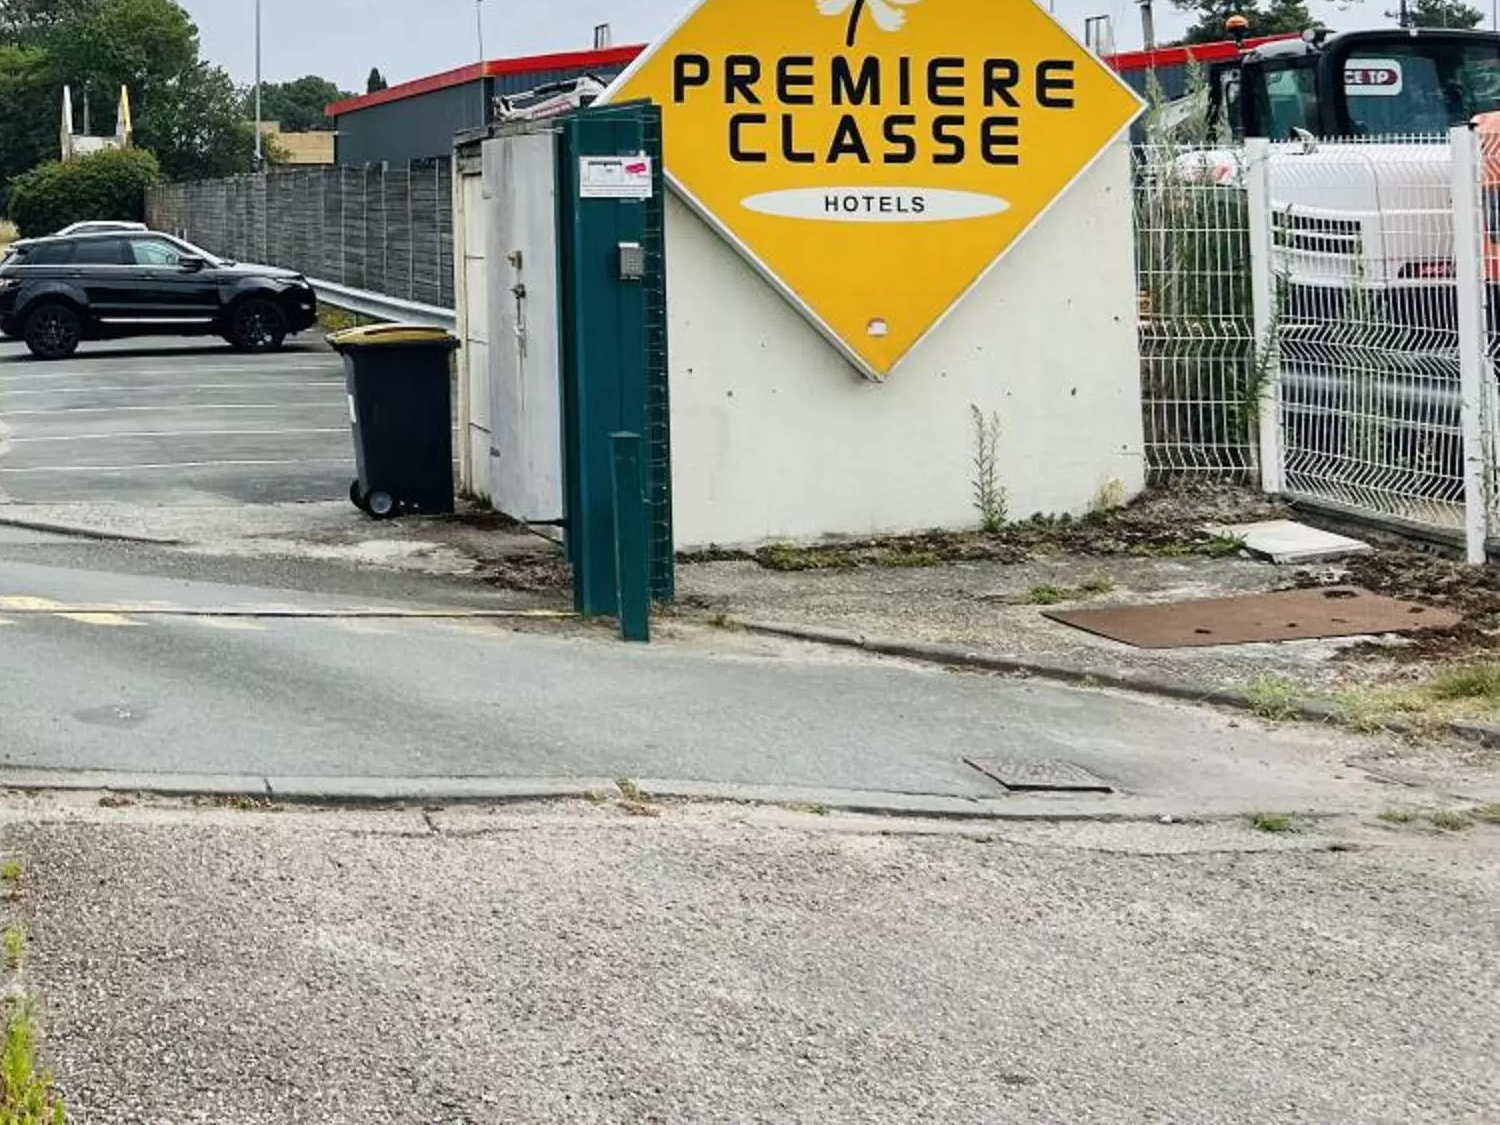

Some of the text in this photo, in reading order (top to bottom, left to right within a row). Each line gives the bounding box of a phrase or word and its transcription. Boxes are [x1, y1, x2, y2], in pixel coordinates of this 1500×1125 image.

[673, 54, 1075, 109] PREMIERE
[729, 113, 1019, 165] CLASSE
[824, 196, 926, 213] HOTELS
